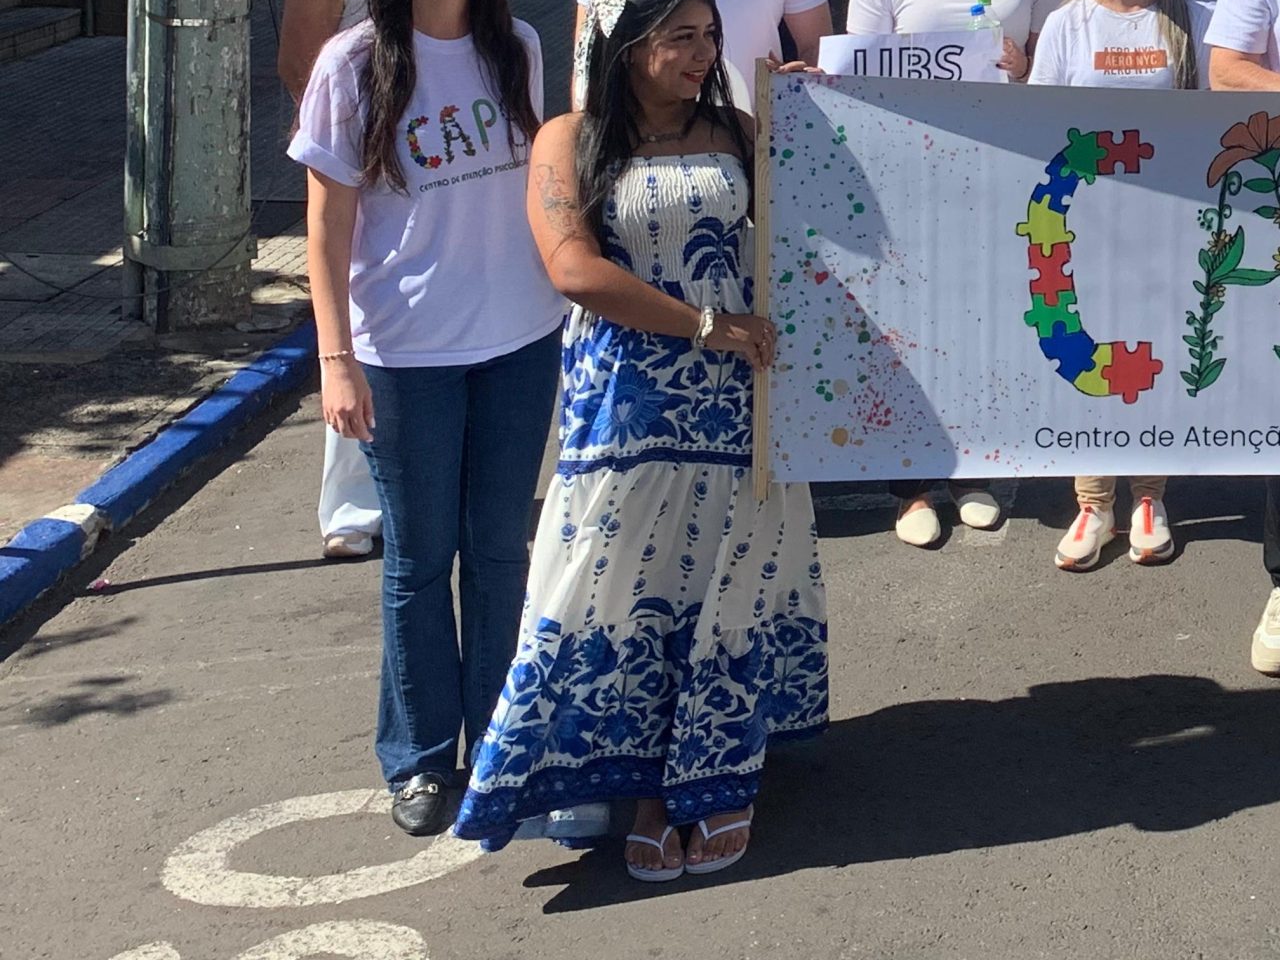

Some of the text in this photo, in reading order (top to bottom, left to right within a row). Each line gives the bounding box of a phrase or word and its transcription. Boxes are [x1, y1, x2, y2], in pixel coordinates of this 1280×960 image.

[1104, 54, 1157, 67] AERO NYC
[419, 178, 450, 193] CENTRO
[451, 175, 460, 185] DE
[461, 166, 494, 182] ATENÇÃO
[1034, 426, 1131, 449] Centro
[1139, 425, 1175, 448] de
